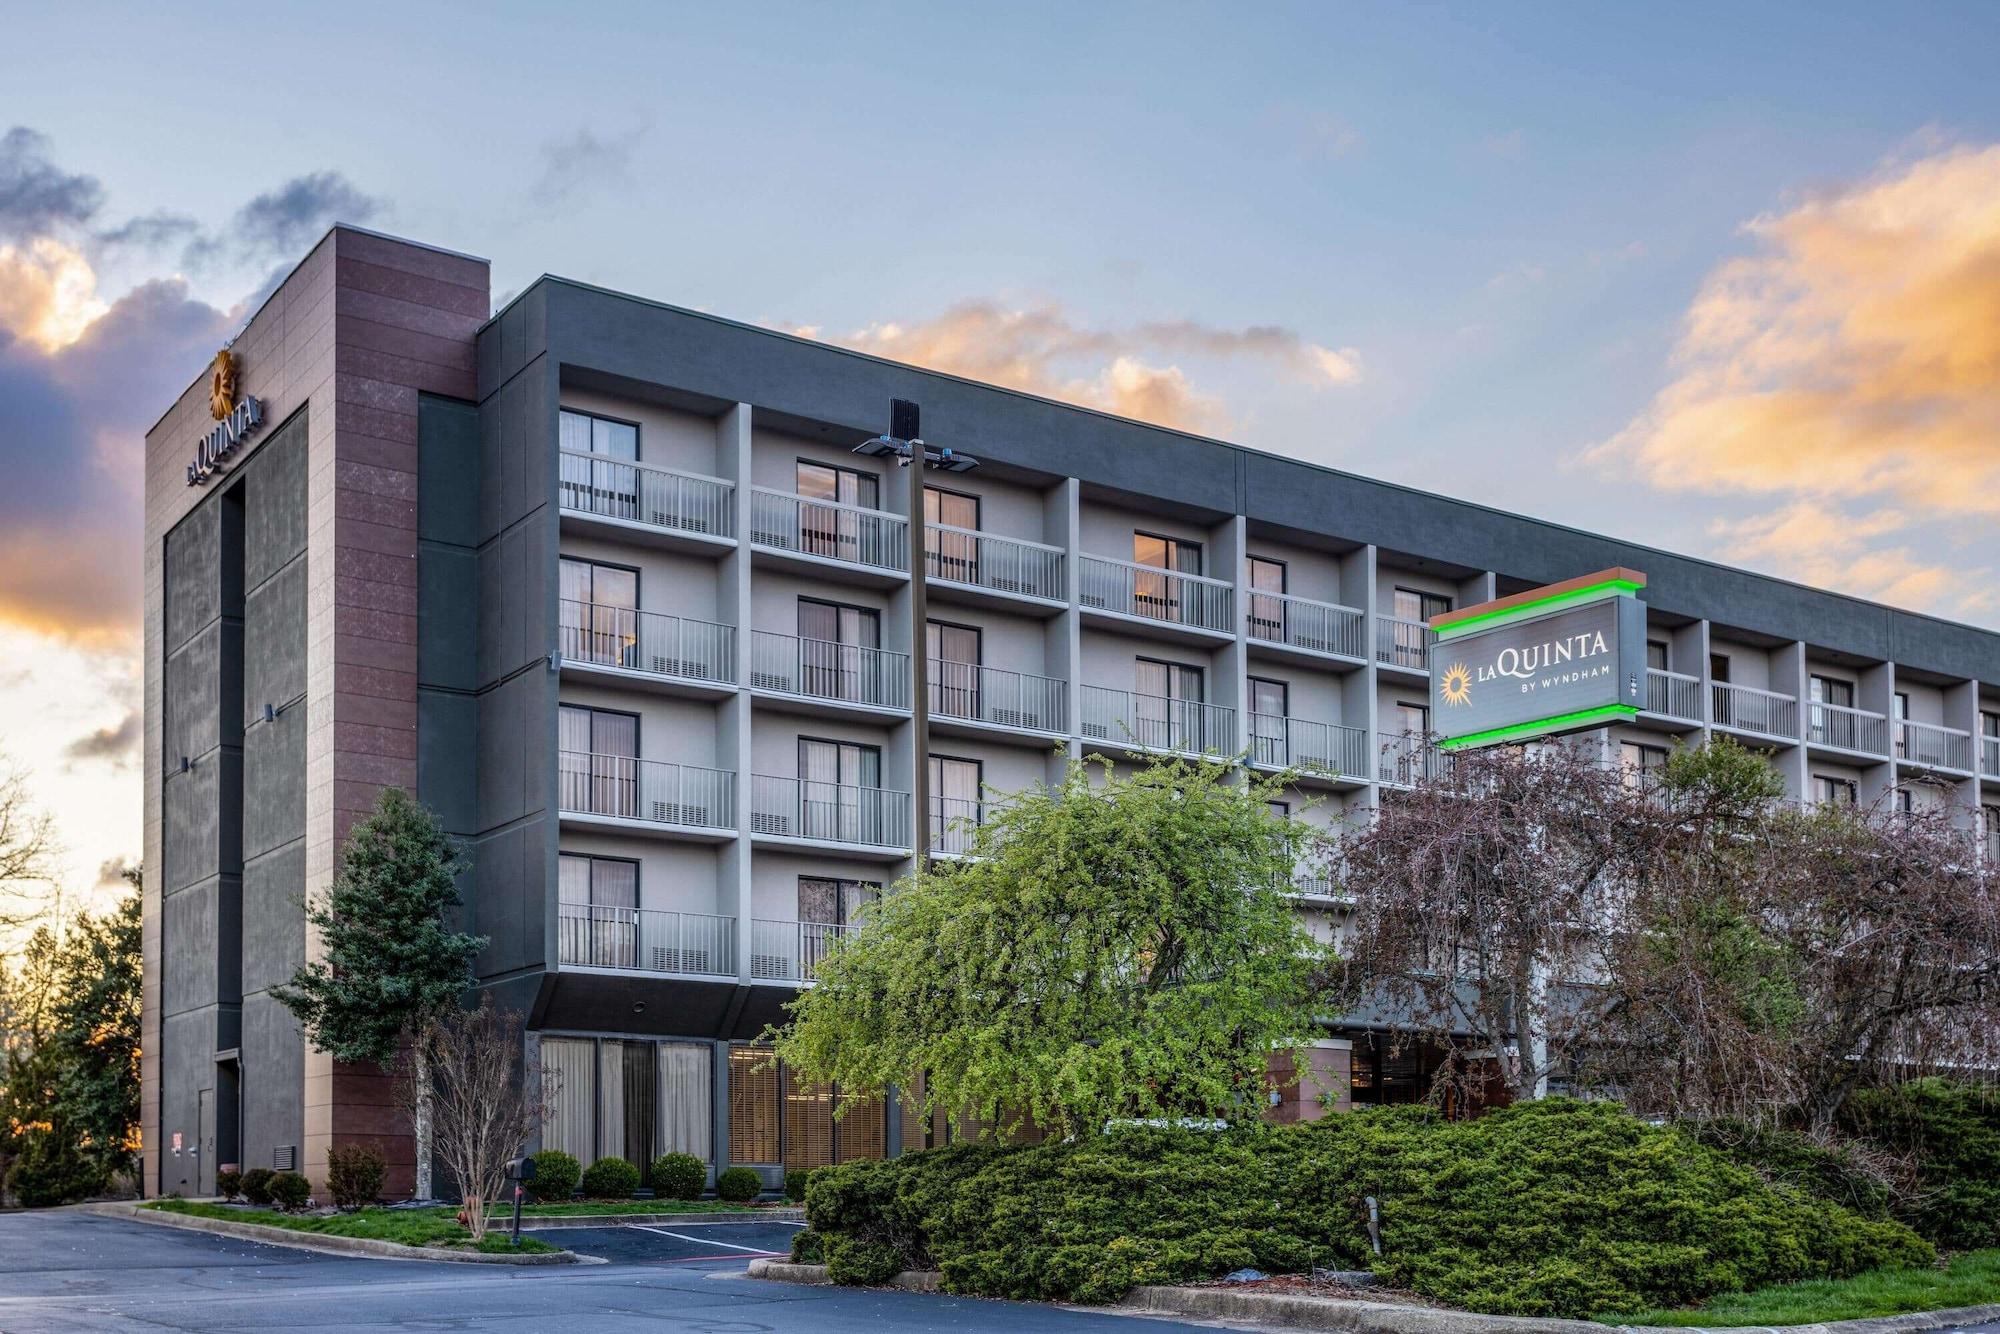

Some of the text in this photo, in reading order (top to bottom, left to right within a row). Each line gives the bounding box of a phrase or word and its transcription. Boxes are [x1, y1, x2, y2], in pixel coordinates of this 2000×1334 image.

[197, 394, 263, 476] QUINTA
[1478, 630, 1609, 682] LA QUINTA
[1521, 665, 1610, 693] BY WYNDHAM
